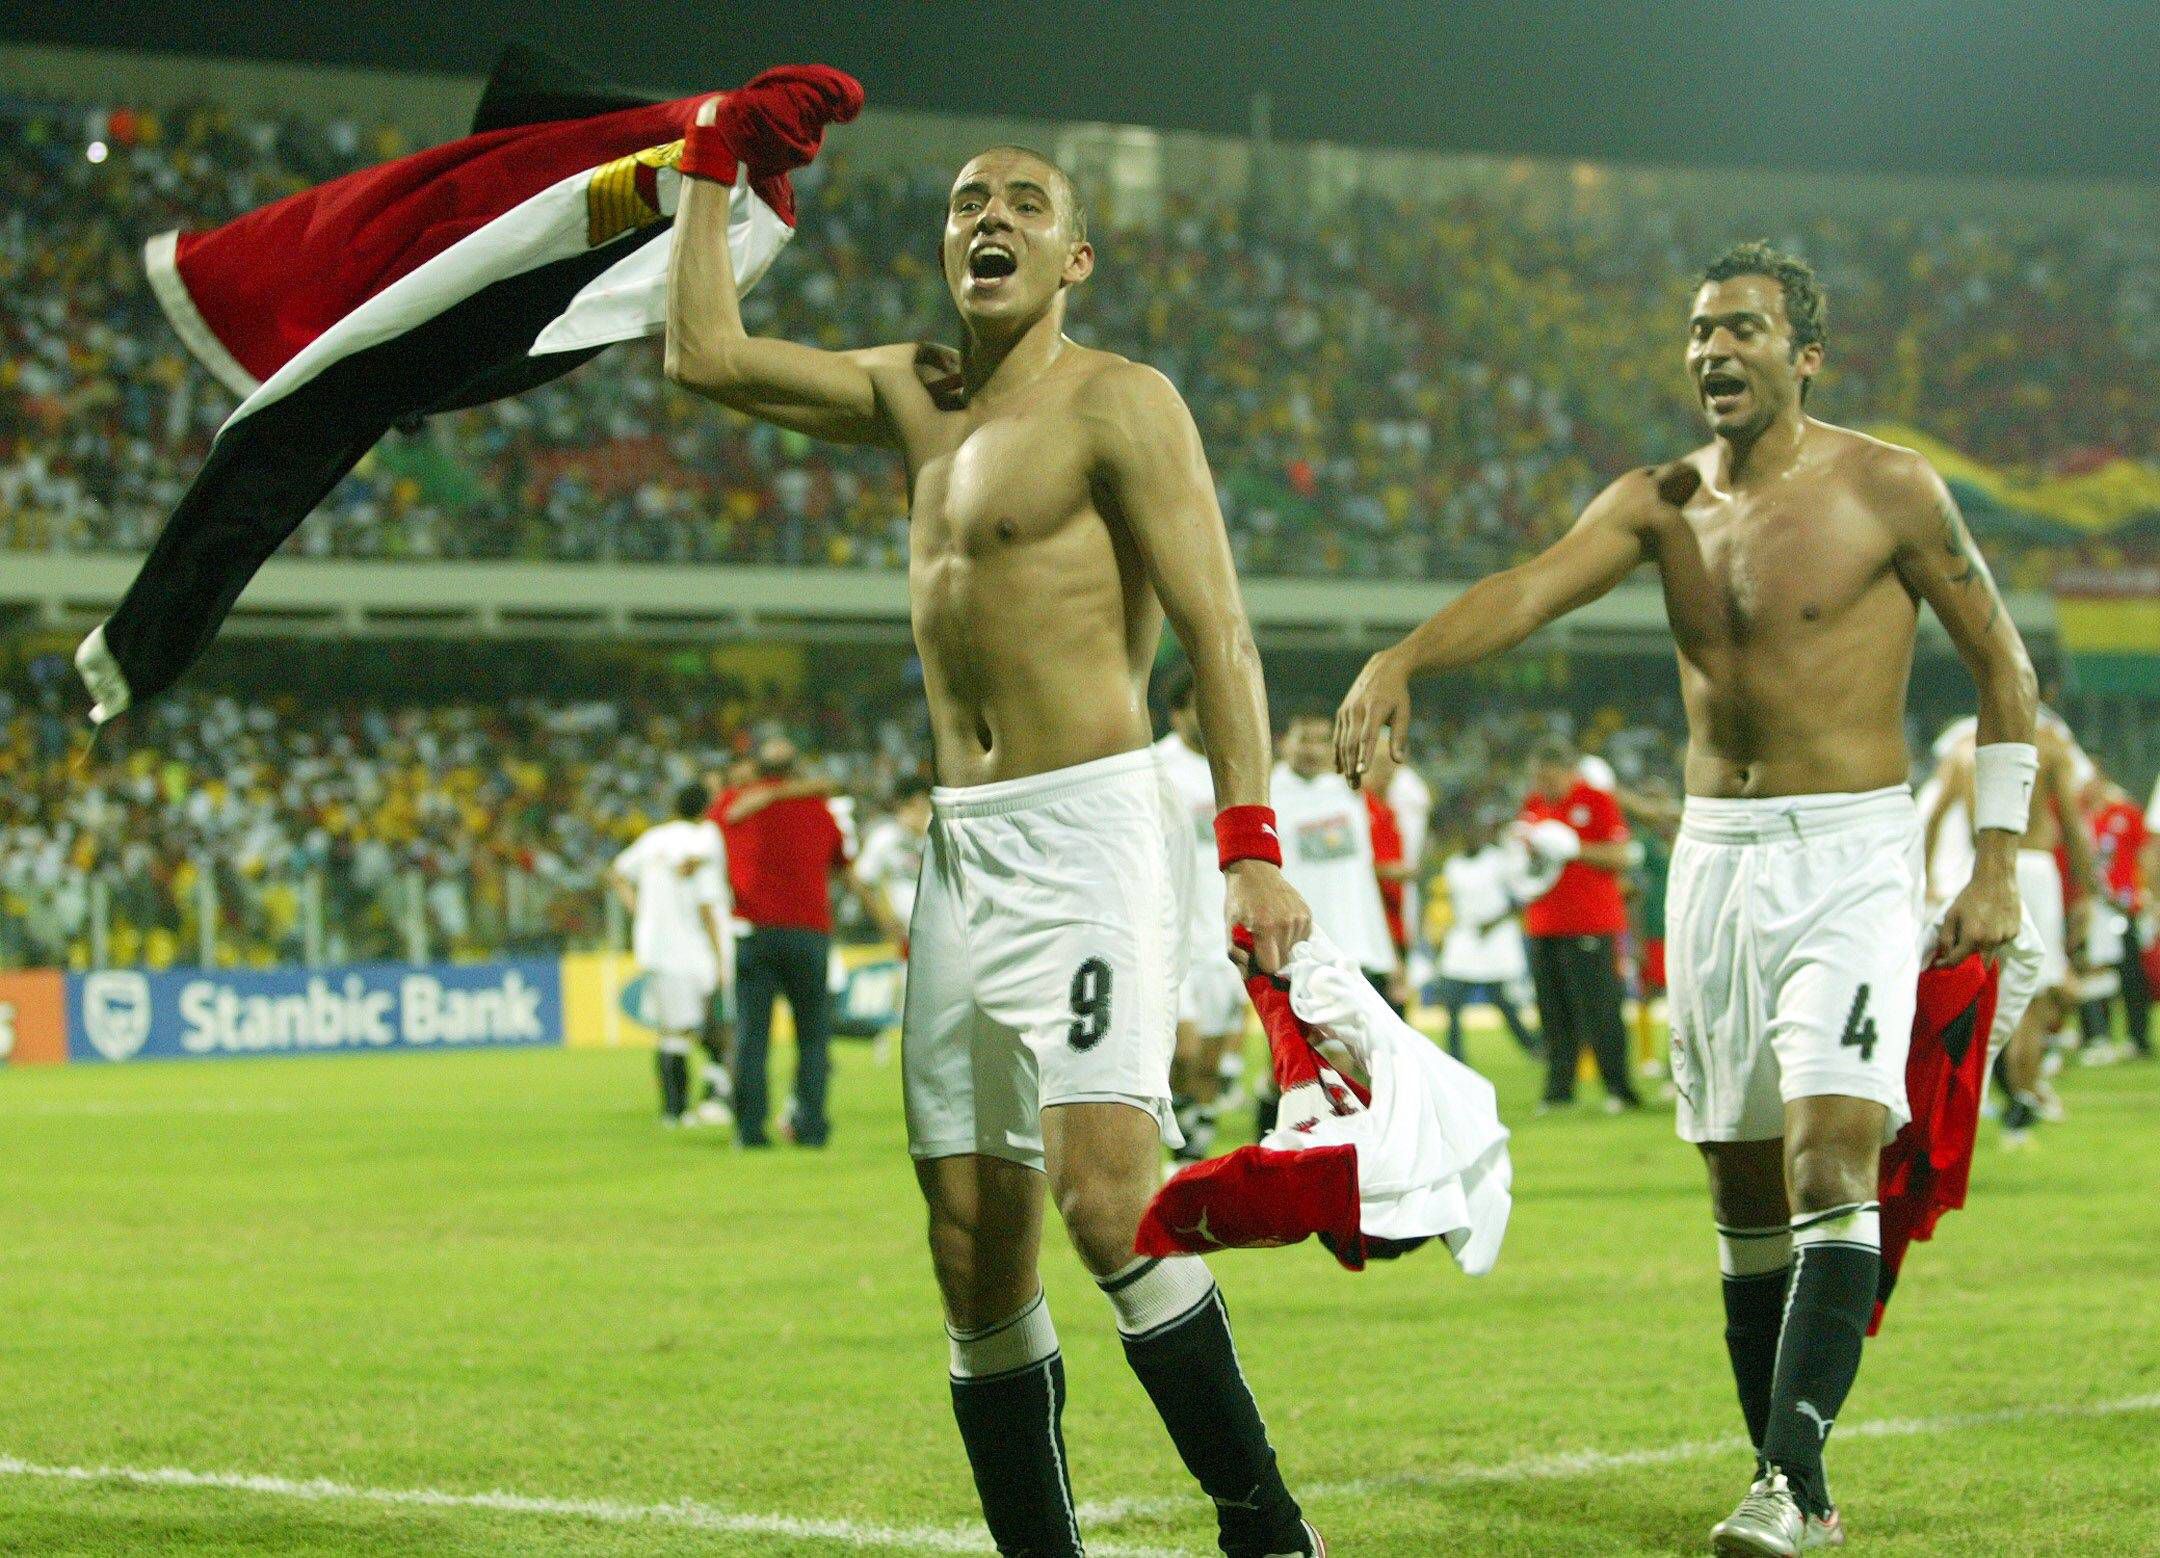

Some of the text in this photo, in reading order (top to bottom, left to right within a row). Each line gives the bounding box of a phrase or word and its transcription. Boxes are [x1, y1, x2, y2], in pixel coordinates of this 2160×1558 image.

[180, 970, 541, 1050] Stanbic Bank
[1068, 957, 1111, 1053] 9
[1840, 983, 1877, 1061] 4
